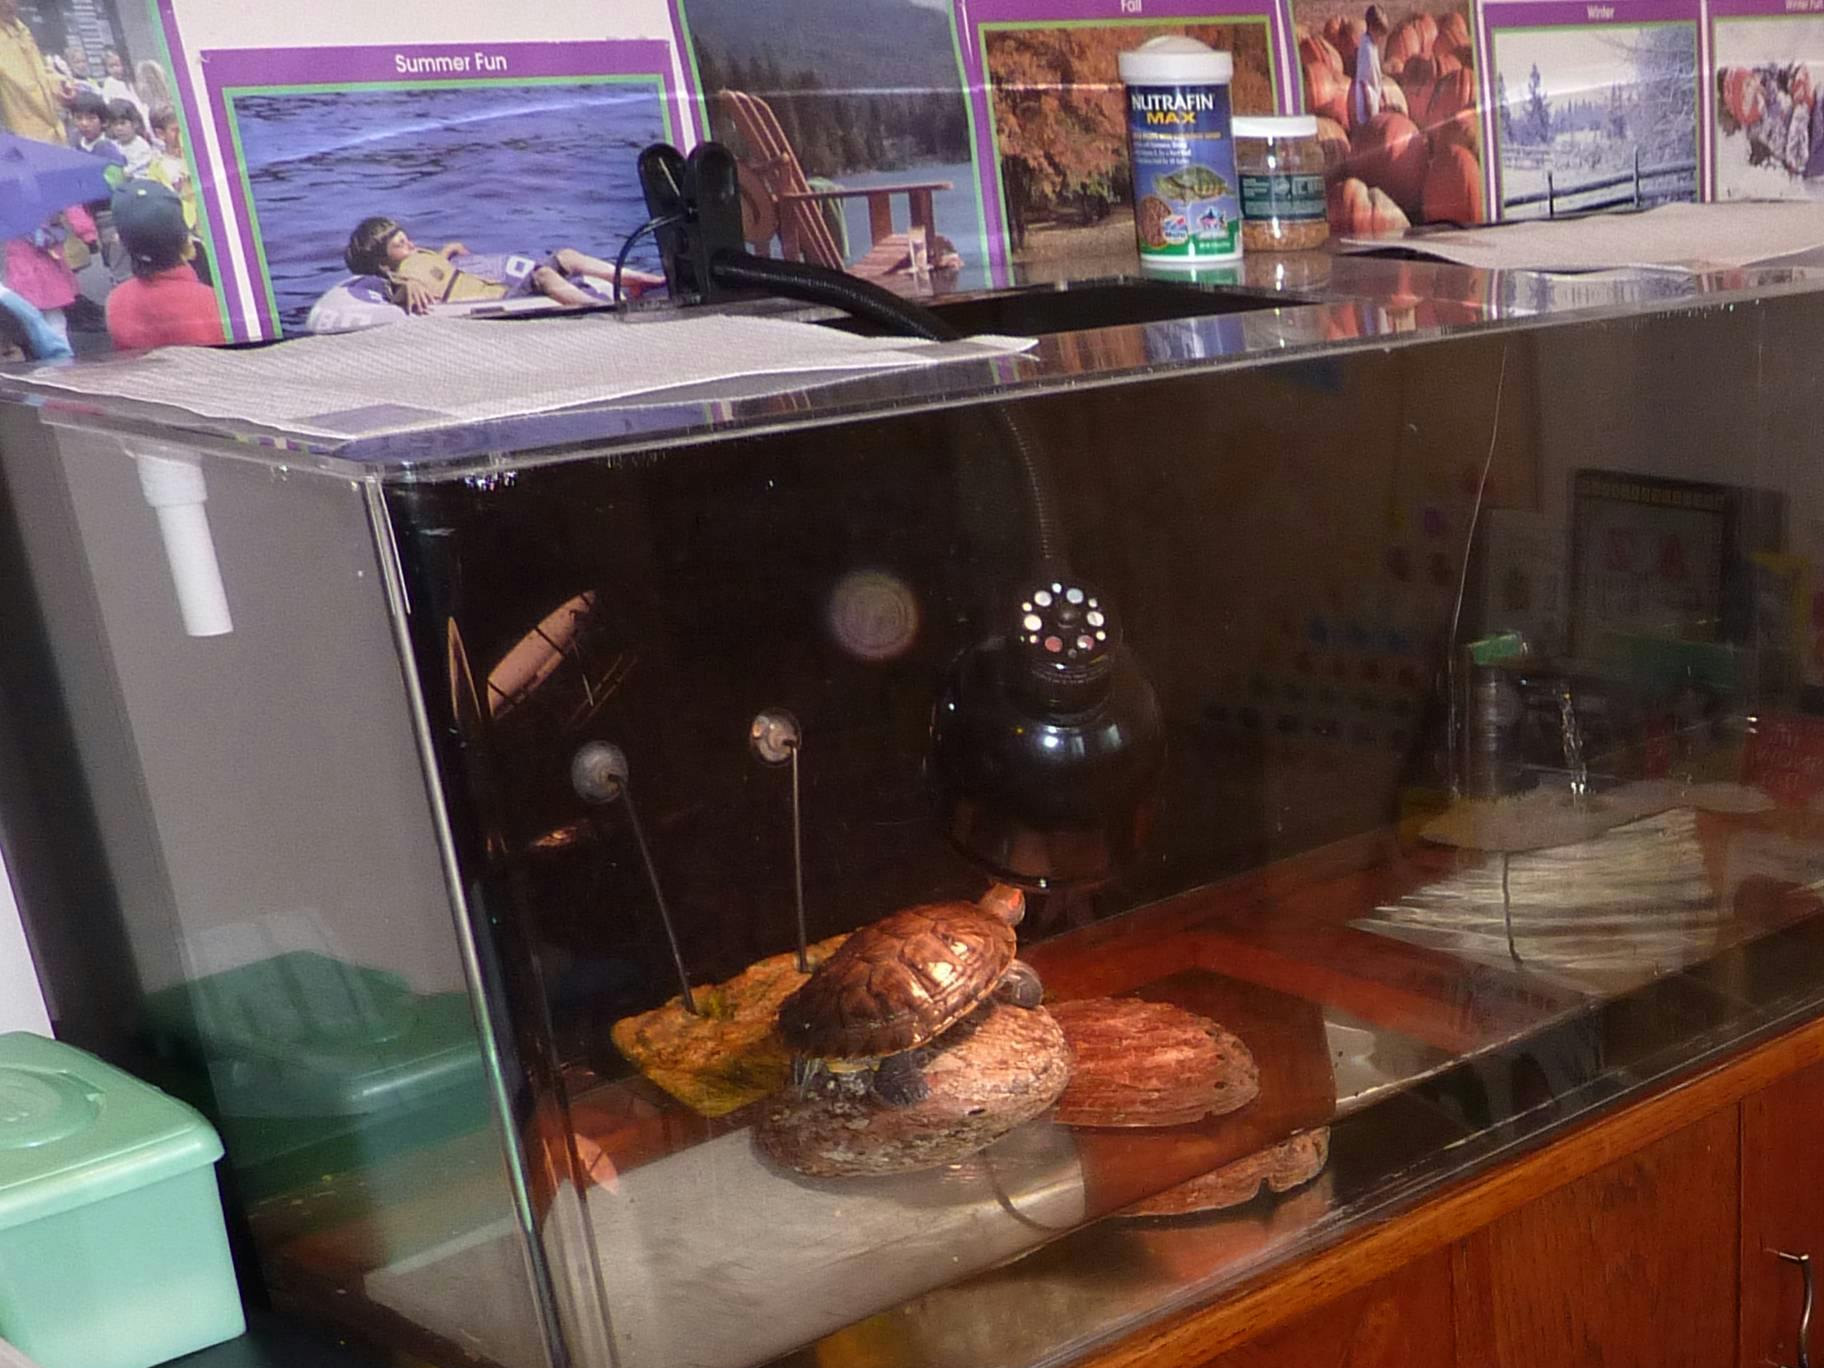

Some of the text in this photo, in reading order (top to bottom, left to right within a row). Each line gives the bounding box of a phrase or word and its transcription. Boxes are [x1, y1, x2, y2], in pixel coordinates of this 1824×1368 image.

[395, 51, 508, 73] Summer Fun
[1131, 93, 1214, 111] NUTRAFIN
[1146, 112, 1196, 125] MAX
